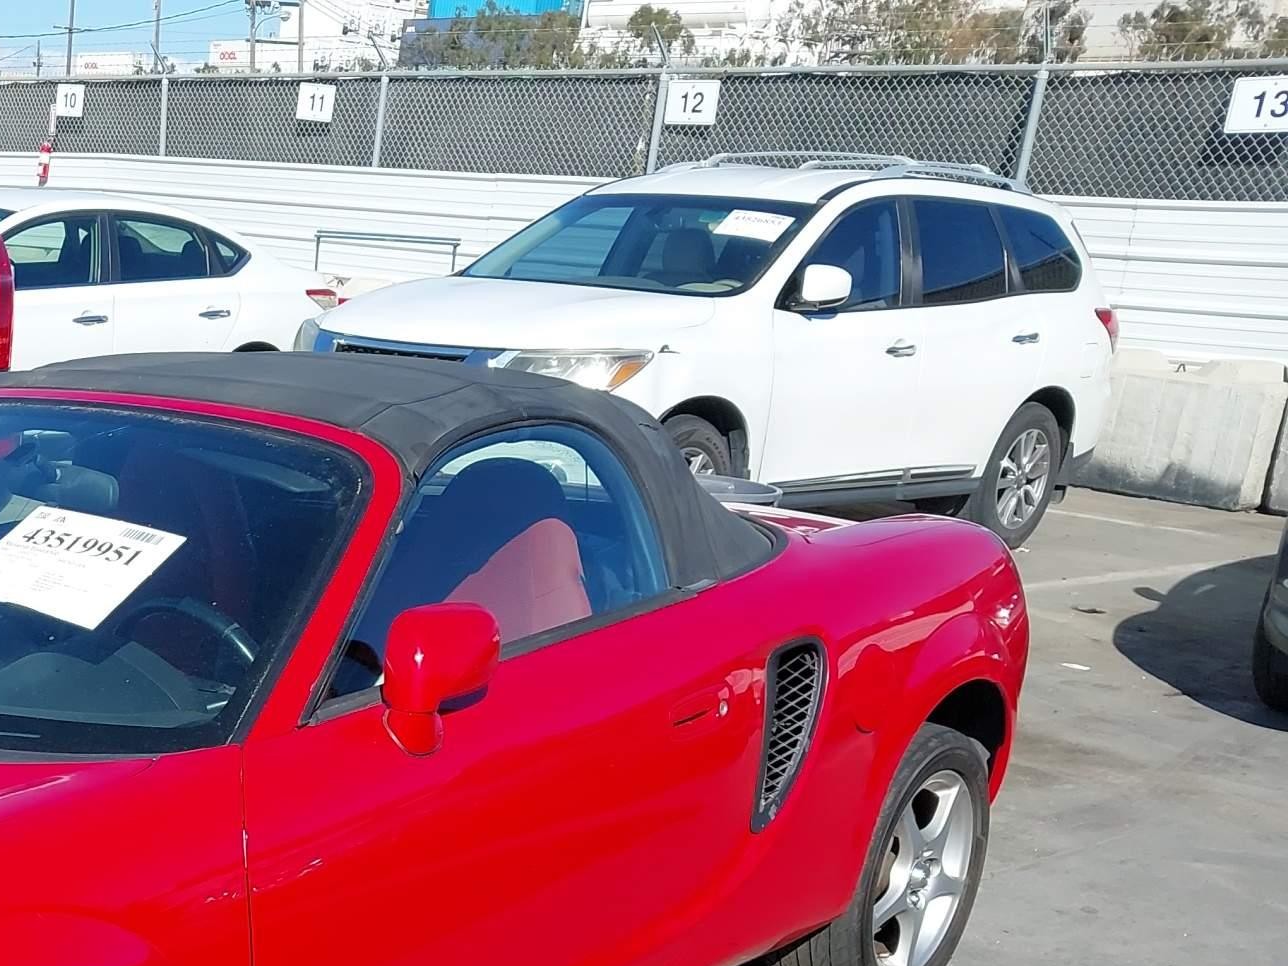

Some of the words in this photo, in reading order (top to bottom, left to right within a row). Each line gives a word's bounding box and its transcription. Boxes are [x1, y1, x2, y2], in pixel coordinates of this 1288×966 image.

[64, 92, 77, 108] 10
[310, 93, 325, 112] 11
[681, 91, 705, 113] 12
[1253, 90, 1288, 118] 13
[22, 528, 142, 566] 43519951
